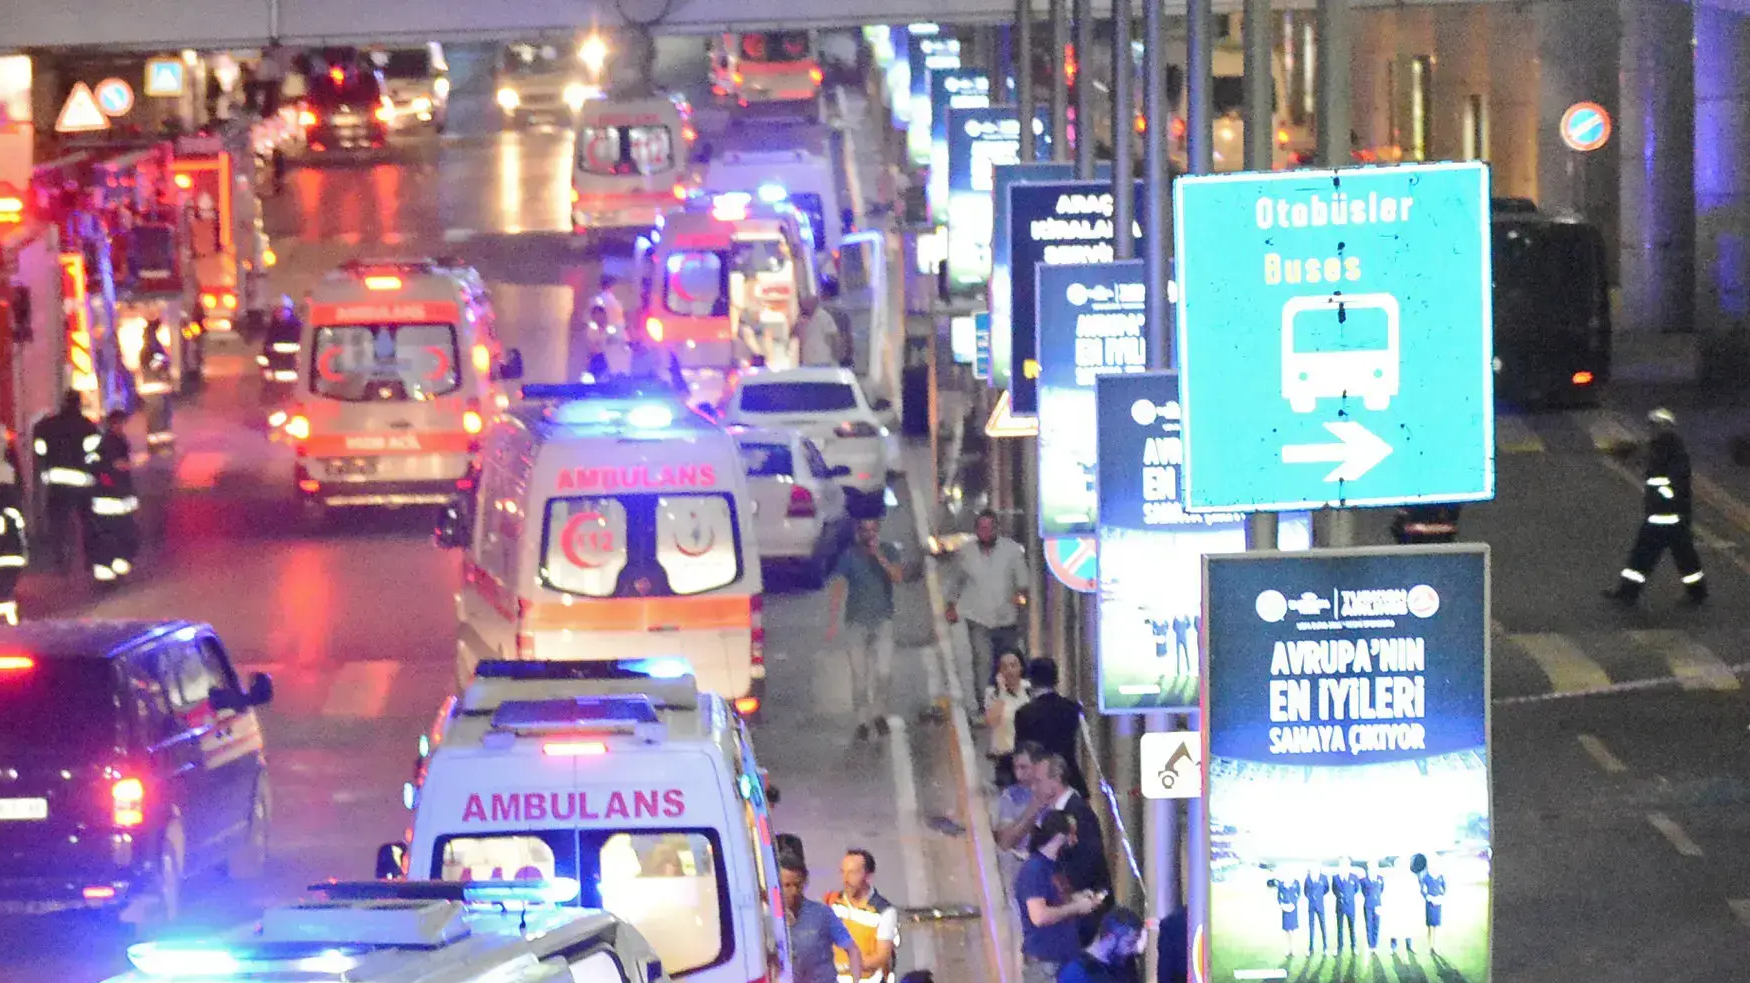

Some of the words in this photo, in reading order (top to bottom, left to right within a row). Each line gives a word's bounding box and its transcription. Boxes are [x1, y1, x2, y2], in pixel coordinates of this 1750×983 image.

[1256, 191, 1413, 229] Otobüsler
[1265, 252, 1361, 285] Buses
[556, 464, 717, 491] AMBULANS
[1270, 637, 1425, 676] AVRUPA'NIN
[1269, 678, 1311, 723] EN
[461, 788, 686, 822] AMBULANS
